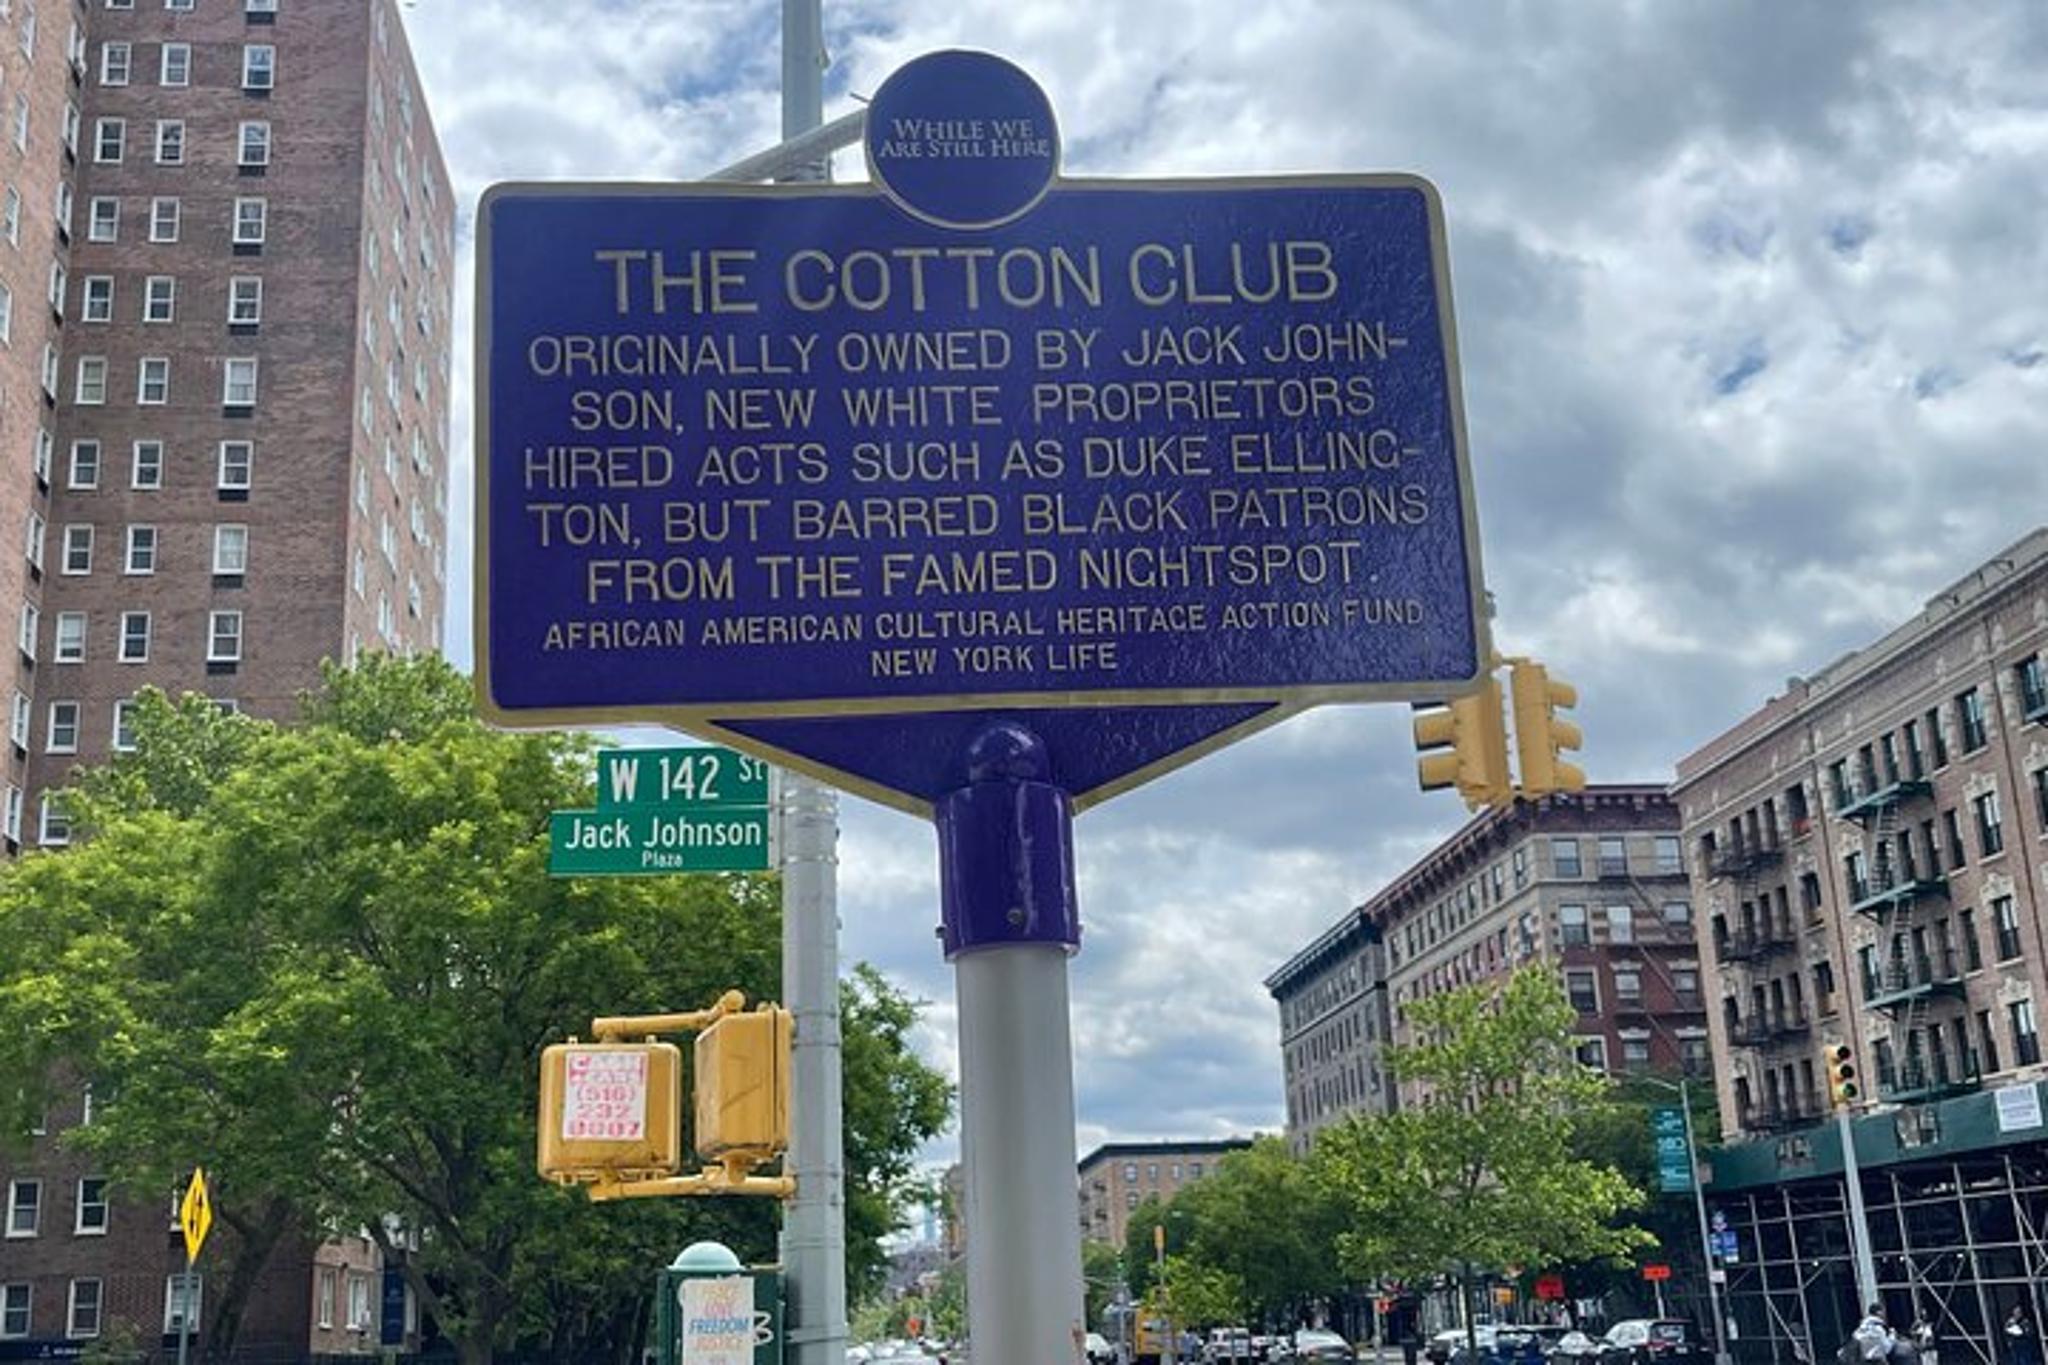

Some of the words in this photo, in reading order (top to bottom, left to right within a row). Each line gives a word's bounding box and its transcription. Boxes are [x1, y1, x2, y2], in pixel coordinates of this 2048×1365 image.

[879, 140, 921, 158] ARE
[929, 140, 985, 157] STILL
[991, 138, 1050, 157] HERE
[892, 118, 984, 140] WHILE
[991, 119, 1034, 139] WE
[594, 249, 758, 314] THE
[785, 243, 1102, 312] COTTON
[1129, 241, 1340, 305] CLUB
[528, 332, 820, 377] ORIGINALLY
[836, 330, 1011, 372] OWNED
[1036, 328, 1099, 370] BY
[1122, 324, 1247, 367] JACK
[1263, 320, 1408, 363] JOHN-
[570, 388, 685, 436] SON,
[706, 386, 818, 430] NEW
[842, 383, 1001, 428] WHITE
[1032, 376, 1376, 424] PROPRIETORS
[524, 445, 674, 490] HIRED
[696, 443, 830, 486] ACTS
[851, 441, 980, 483] SUCH
[1001, 439, 1065, 481] AS
[1083, 436, 1212, 479] DUKE
[1232, 429, 1424, 474] ELLING-
[526, 502, 642, 548] TON,
[663, 499, 771, 543] BUT
[793, 494, 998, 540] BARRED
[1023, 489, 1188, 535] BLACK
[1210, 484, 1430, 530] PATRONS
[587, 556, 735, 604] FROM
[756, 554, 863, 599] THE
[882, 550, 1057, 596] FAMED
[1080, 541, 1380, 590] NIGHTSPOT.
[543, 618, 686, 650] AFRICAN
[701, 613, 864, 646] AMERICAN
[874, 608, 1045, 640] CULTURAL
[1057, 603, 1208, 636] HERITAGE
[1221, 601, 1331, 630] ACTION
[1344, 600, 1424, 626] FUND
[870, 648, 938, 677] NEW
[952, 644, 1034, 674] YORK
[1048, 641, 1119, 671] LIFE
[611, 758, 638, 803] W
[659, 754, 720, 801] 142
[739, 753, 764, 783] St
[565, 818, 631, 849] Jack
[642, 816, 761, 848] Johnson
[641, 852, 684, 868] Plaza
